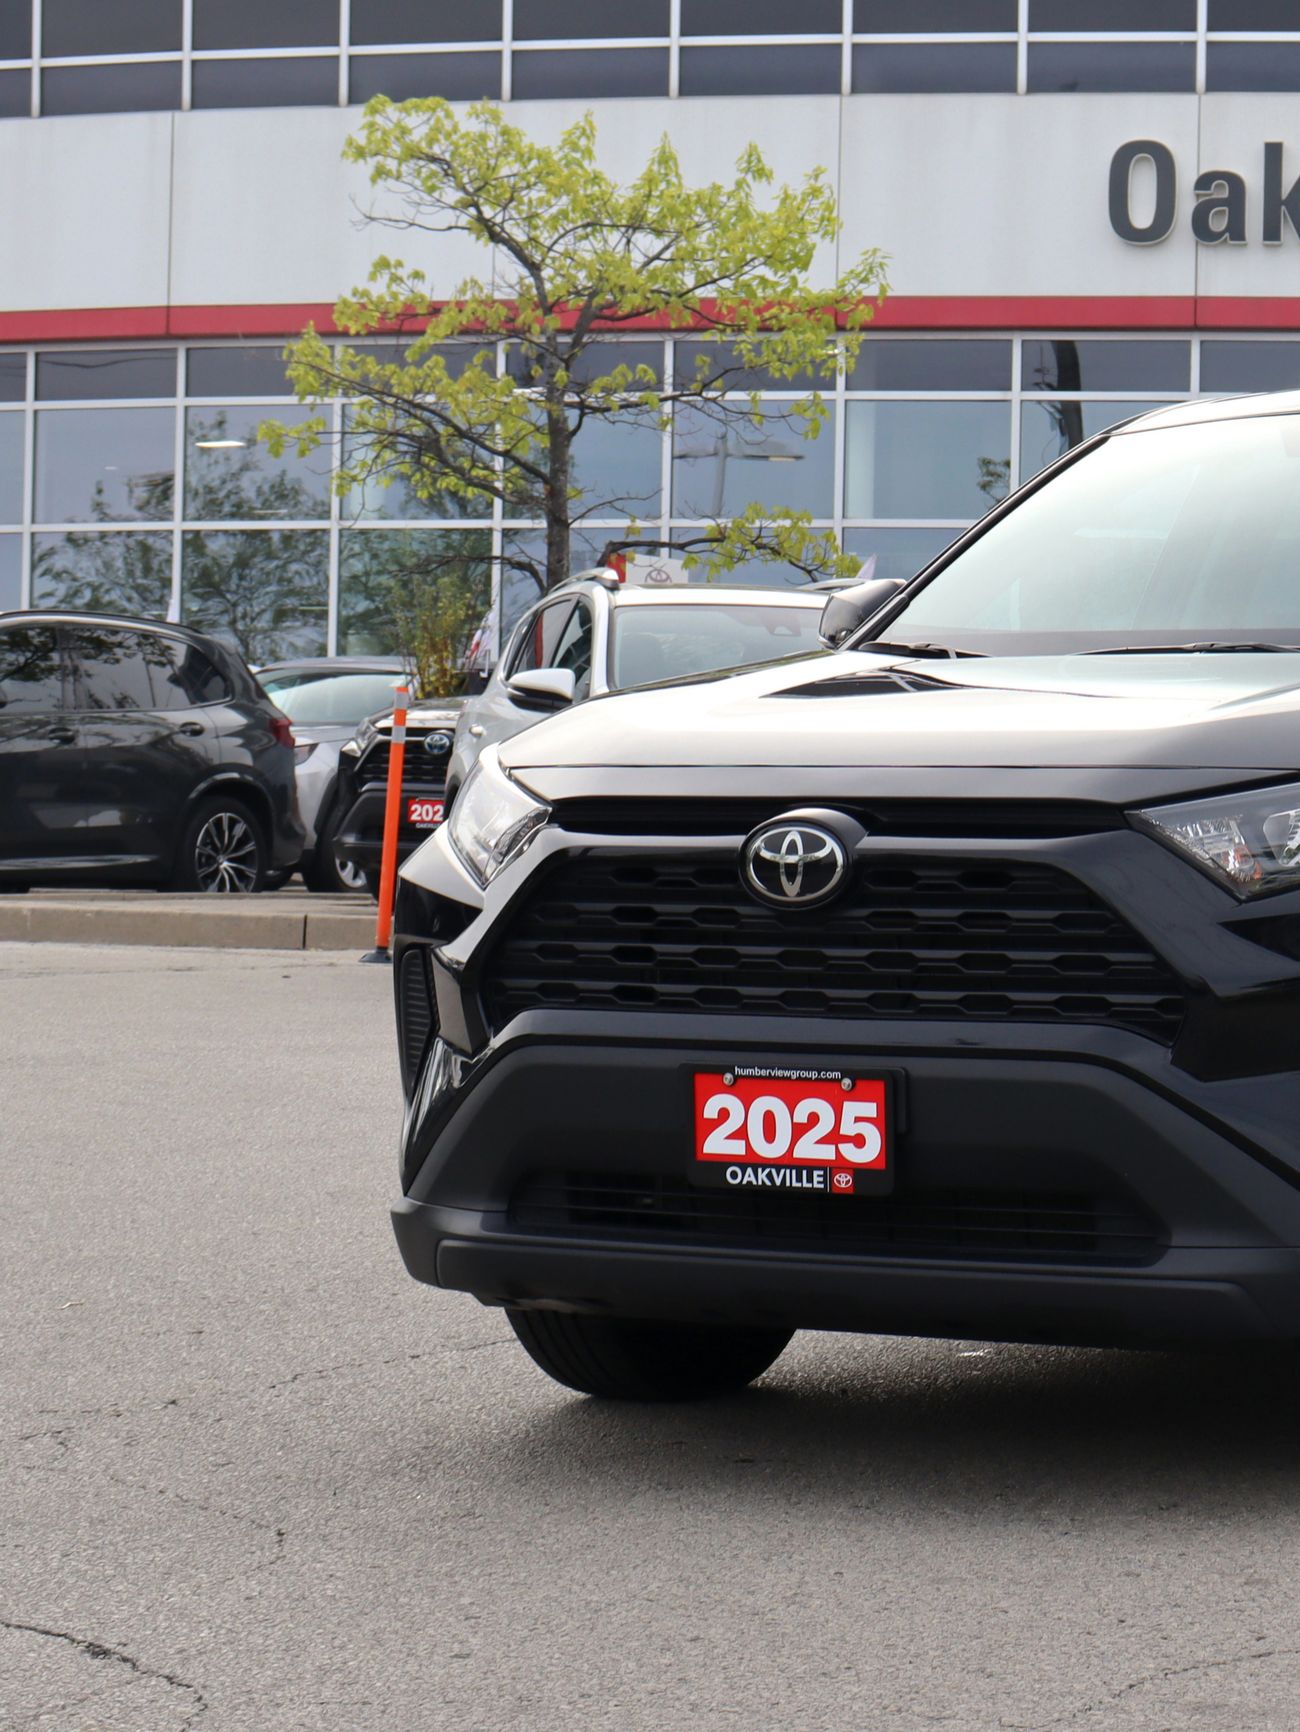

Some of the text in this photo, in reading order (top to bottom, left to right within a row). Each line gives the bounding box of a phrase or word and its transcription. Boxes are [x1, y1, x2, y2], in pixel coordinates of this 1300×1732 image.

[410, 804, 444, 821] 202
[734, 1065, 841, 1080] humberviewgroup.com
[702, 1093, 882, 1164] 2025
[726, 1166, 825, 1189] OAKVILLE
